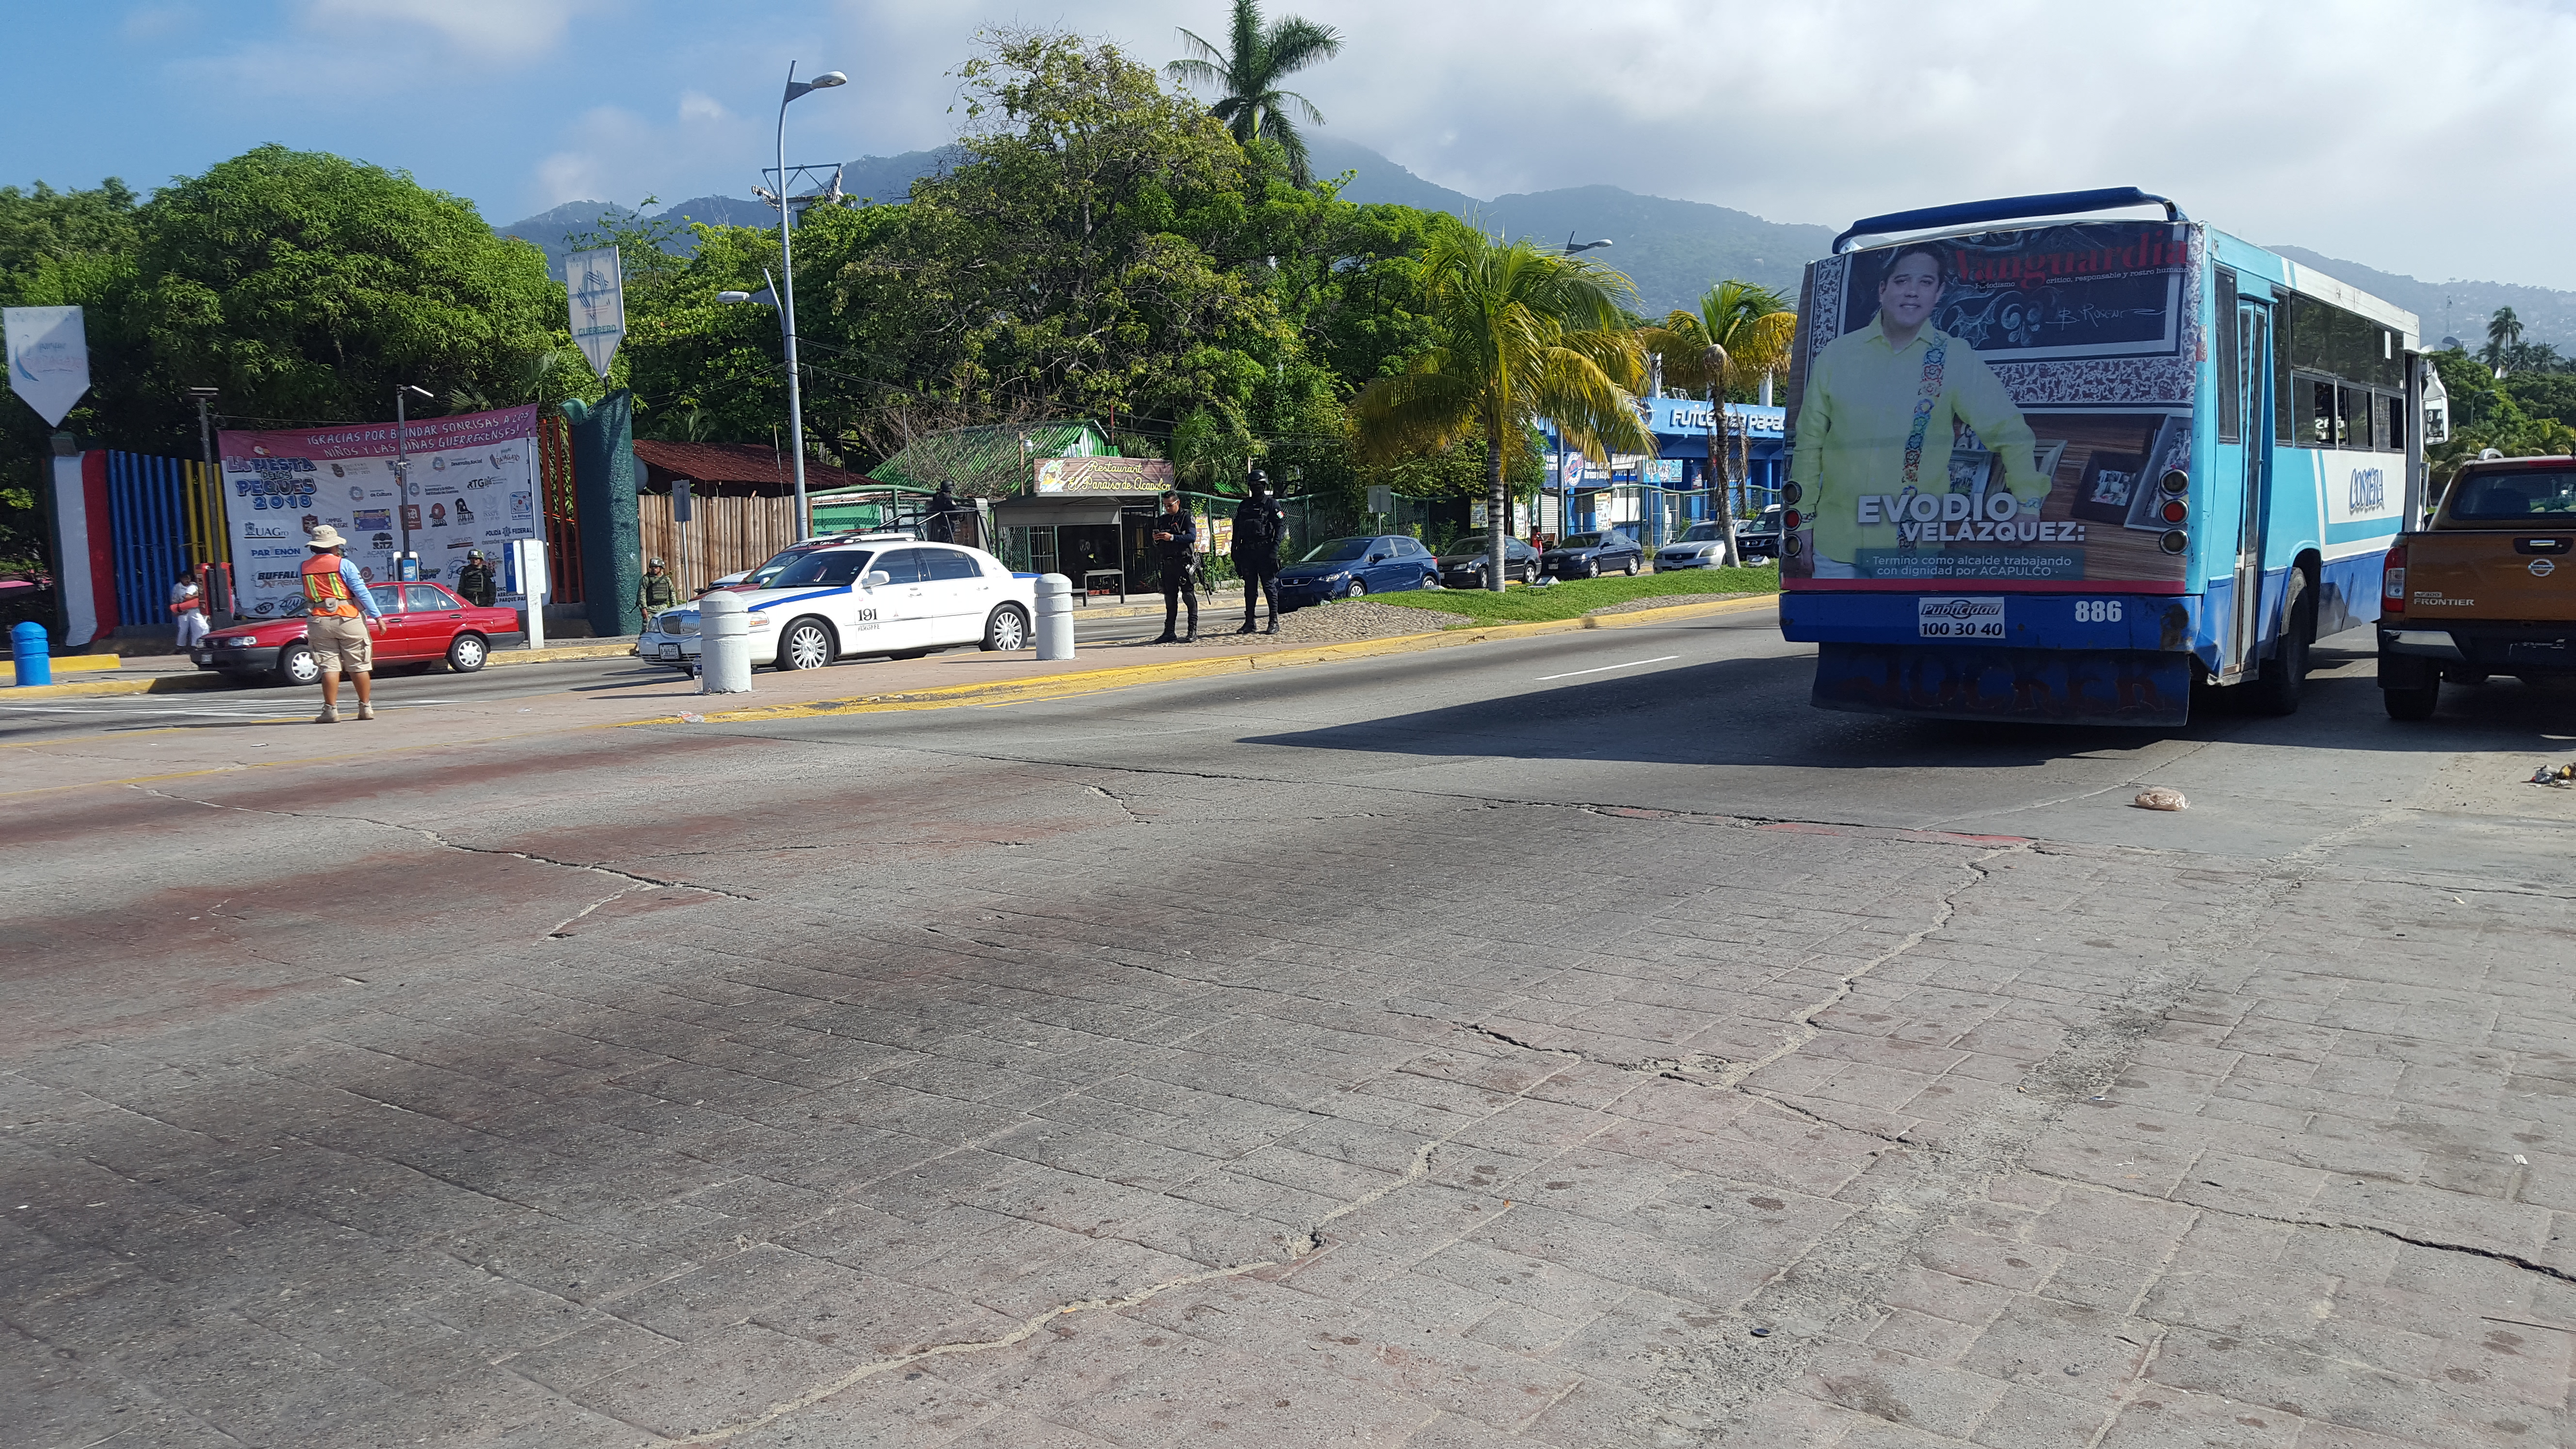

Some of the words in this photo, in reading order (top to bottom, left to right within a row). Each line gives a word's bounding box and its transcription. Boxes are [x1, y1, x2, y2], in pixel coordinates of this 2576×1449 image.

[1955, 230, 2188, 290] Vanguardia
[2075, 272, 2121, 283] responsable
[579, 325, 616, 337] GUERRERO
[1672, 408, 1748, 428] FUTCETER
[307, 431, 361, 446] ¡GRACIAS
[365, 430, 386, 441] POR
[390, 424, 438, 439] BINDAR
[442, 417, 499, 434] SONRISAS
[503, 415, 510, 425] A
[512, 409, 531, 423] LOS
[323, 445, 359, 458] NIÑOS
[361, 446, 369, 455] Y
[372, 443, 396, 454] LAS
[438, 424, 520, 448] GUERRERENSES!
[226, 456, 251, 472] LA
[250, 456, 317, 472] FIESTA
[1087, 460, 1143, 474] Restaurant
[235, 477, 317, 497] PEQUES
[1067, 477, 1079, 491] El
[1082, 476, 1120, 490] Paraíso
[1121, 479, 1132, 490] de
[1134, 477, 1171, 491] Acapulco
[2350, 467, 2385, 515] COSTERA
[253, 494, 313, 509] 2018
[1857, 492, 2018, 524] EVODIO
[1901, 517, 2086, 542] VELÁZQUEZ:
[1921, 557, 1955, 565] como
[1957, 555, 2001, 565] alcalde
[2004, 555, 2072, 568] trabajando
[258, 571, 299, 580] BUFFAL
[1901, 565, 1952, 577] dignidad
[1956, 567, 1977, 577] por
[1979, 566, 2051, 577] ACAPULCO
[1923, 604, 2003, 615] Publicidad
[2414, 598, 2475, 606] FRONTIER
[857, 608, 878, 621] 191
[2075, 600, 2123, 623] 886
[1922, 622, 1950, 636] 100
[1954, 622, 1977, 636] 30
[1980, 622, 2003, 636] 40
